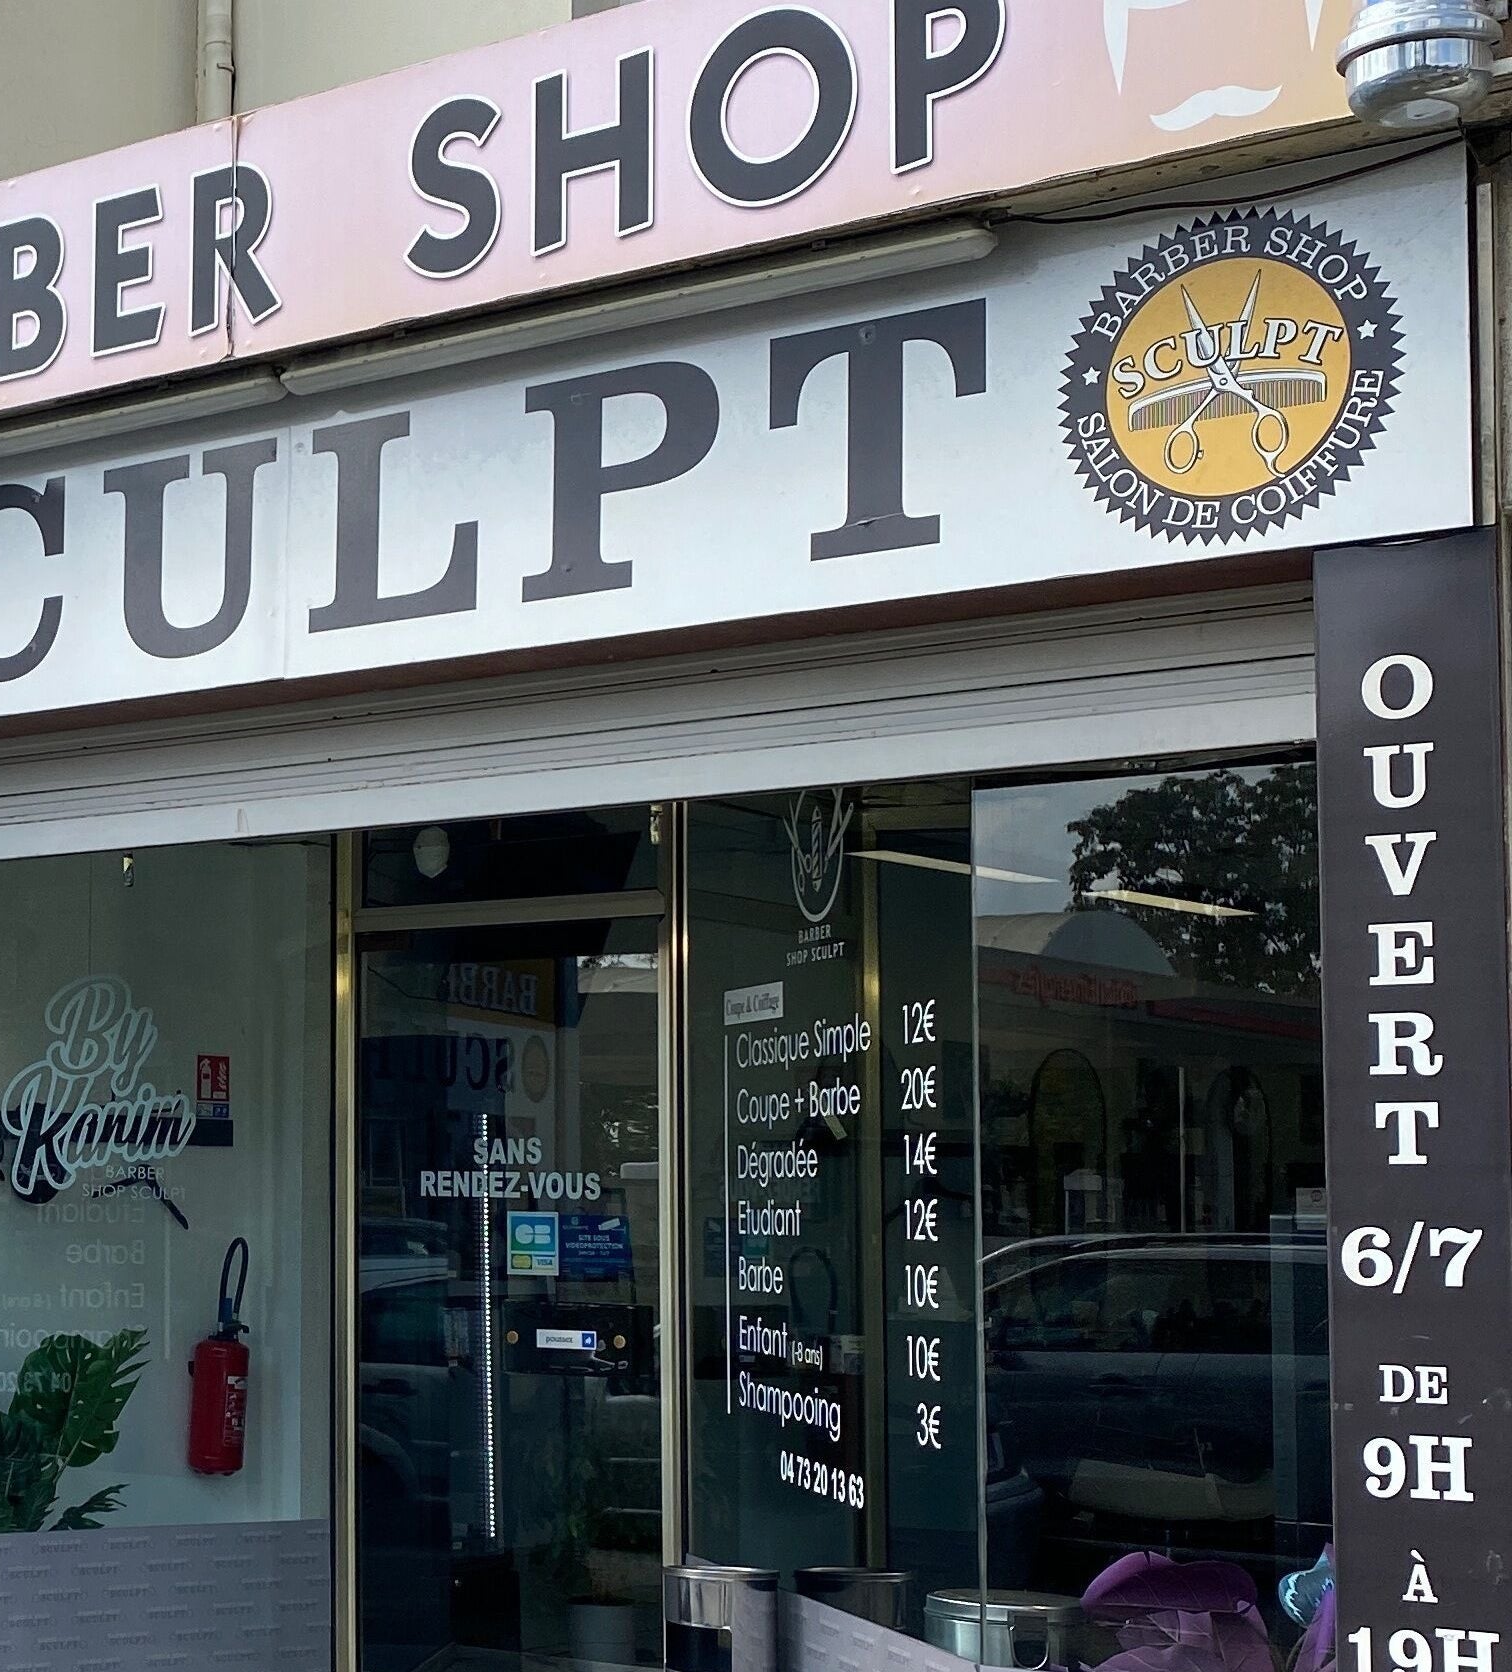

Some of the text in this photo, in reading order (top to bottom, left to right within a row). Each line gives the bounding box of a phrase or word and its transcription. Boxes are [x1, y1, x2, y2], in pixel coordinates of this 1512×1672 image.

[403, 0, 1006, 280] SHOP
[1090, 224, 1369, 342] BARBER SHOP
[1112, 317, 1344, 400] SCULPT
[1076, 368, 1385, 529] SALON DE COIFFURE
[798, 924, 832, 944] BARBER
[1360, 654, 1445, 1166] OUVERT
[786, 941, 845, 967] SHOP SCULPT
[44, 973, 158, 1097] By
[737, 998, 936, 1070] Classique Simple 12€
[1, 1059, 197, 1195] Karim
[737, 1087, 790, 1129] Coupe
[809, 1077, 861, 1118] Barbe
[901, 1065, 937, 1110] 20€
[106, 1165, 165, 1181] BARBER
[473, 1137, 542, 1165] SANS
[737, 1131, 938, 1188] Dégradée 14€
[82, 1183, 127, 1199] SHOP
[420, 1170, 602, 1201] RENDEZ-VOUS
[738, 1198, 938, 1242] Etudiant 12€
[738, 1256, 939, 1309] Barbe 10€
[1340, 1220, 1483, 1295] 6/7
[739, 1315, 788, 1359] Enfant
[906, 1335, 941, 1382] 10€
[738, 1370, 942, 1450] Shampooing 3€
[1378, 1363, 1449, 1405] DE
[779, 1450, 865, 1510] 04 73 20 13 63
[1362, 1434, 1475, 1503] 9H
[1402, 1549, 1438, 1604] À
[1347, 1626, 1500, 1672] 19H
